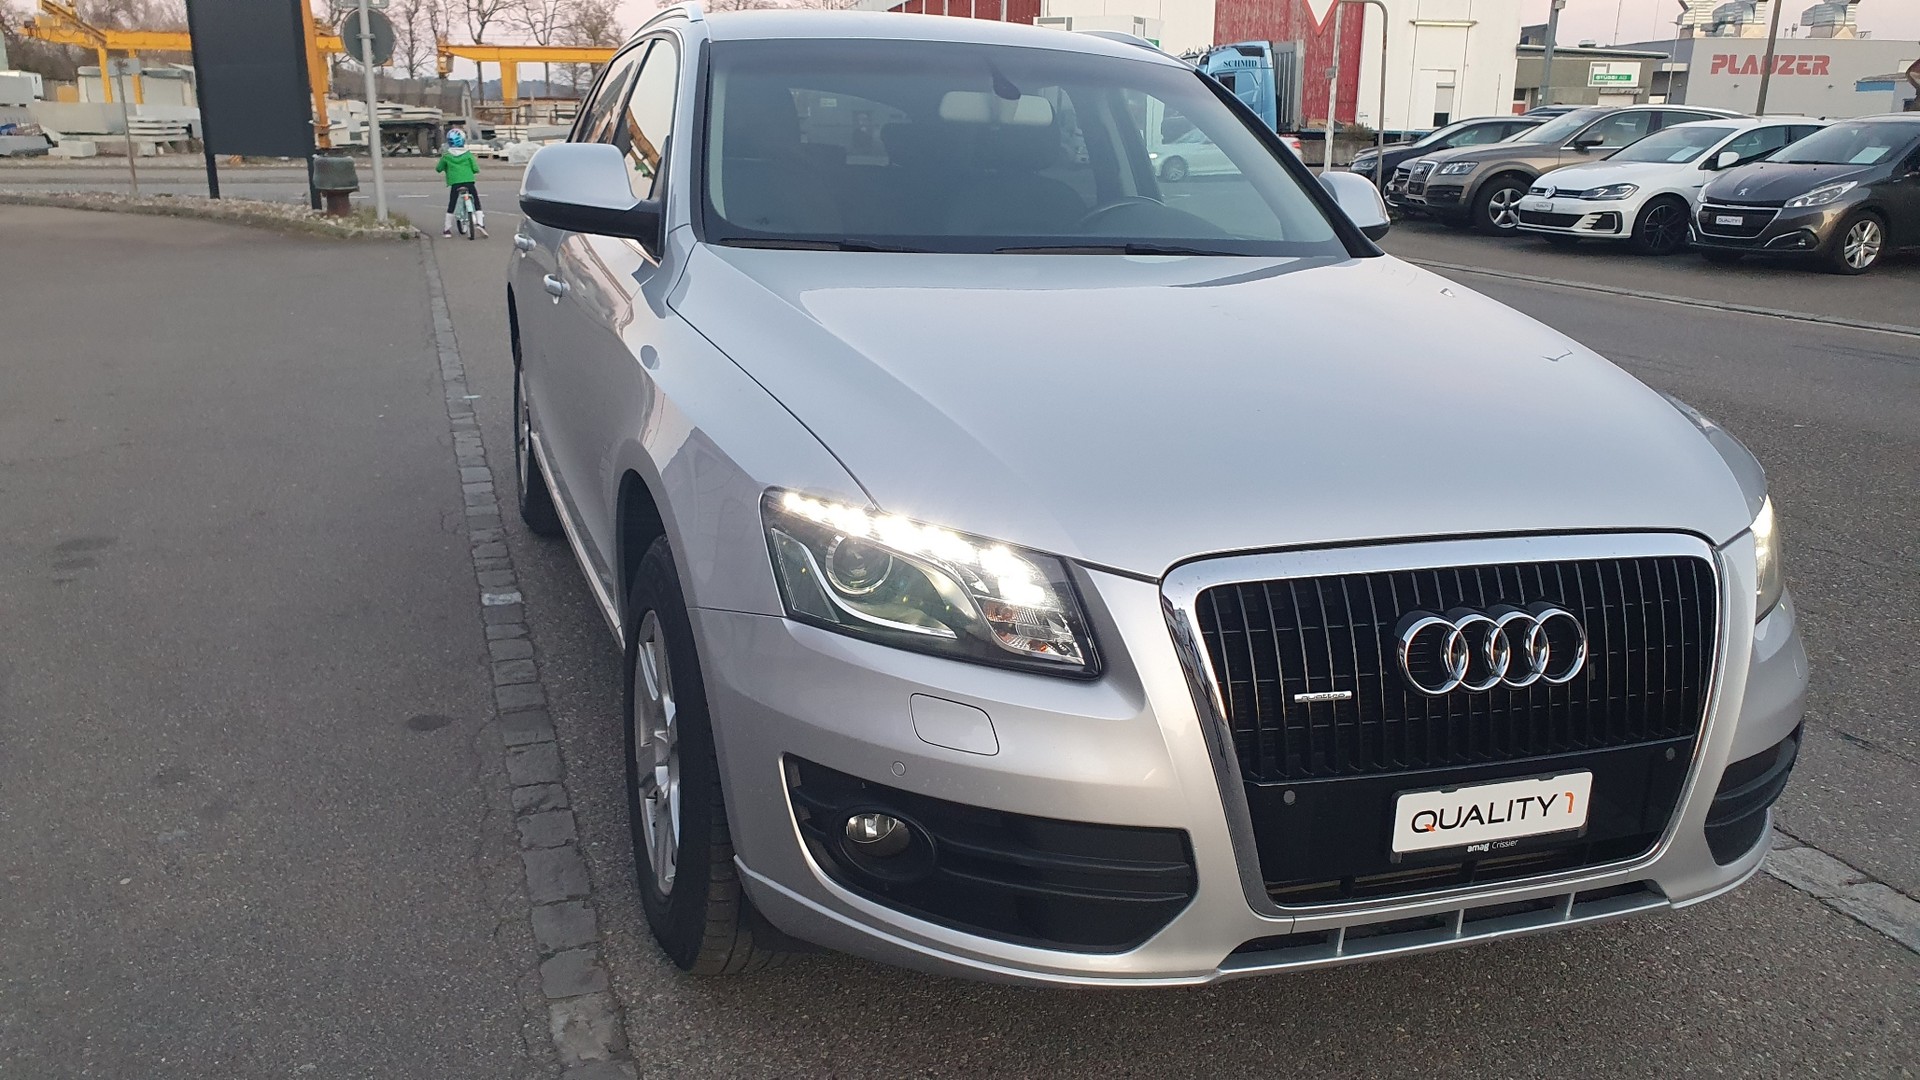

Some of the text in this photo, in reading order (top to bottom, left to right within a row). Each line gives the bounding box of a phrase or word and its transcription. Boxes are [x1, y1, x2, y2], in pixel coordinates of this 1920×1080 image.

[1223, 59, 1257, 68] SCHMID
[1411, 792, 1574, 833] QUALITY 1
[1466, 839, 1519, 853] amag Crissier
